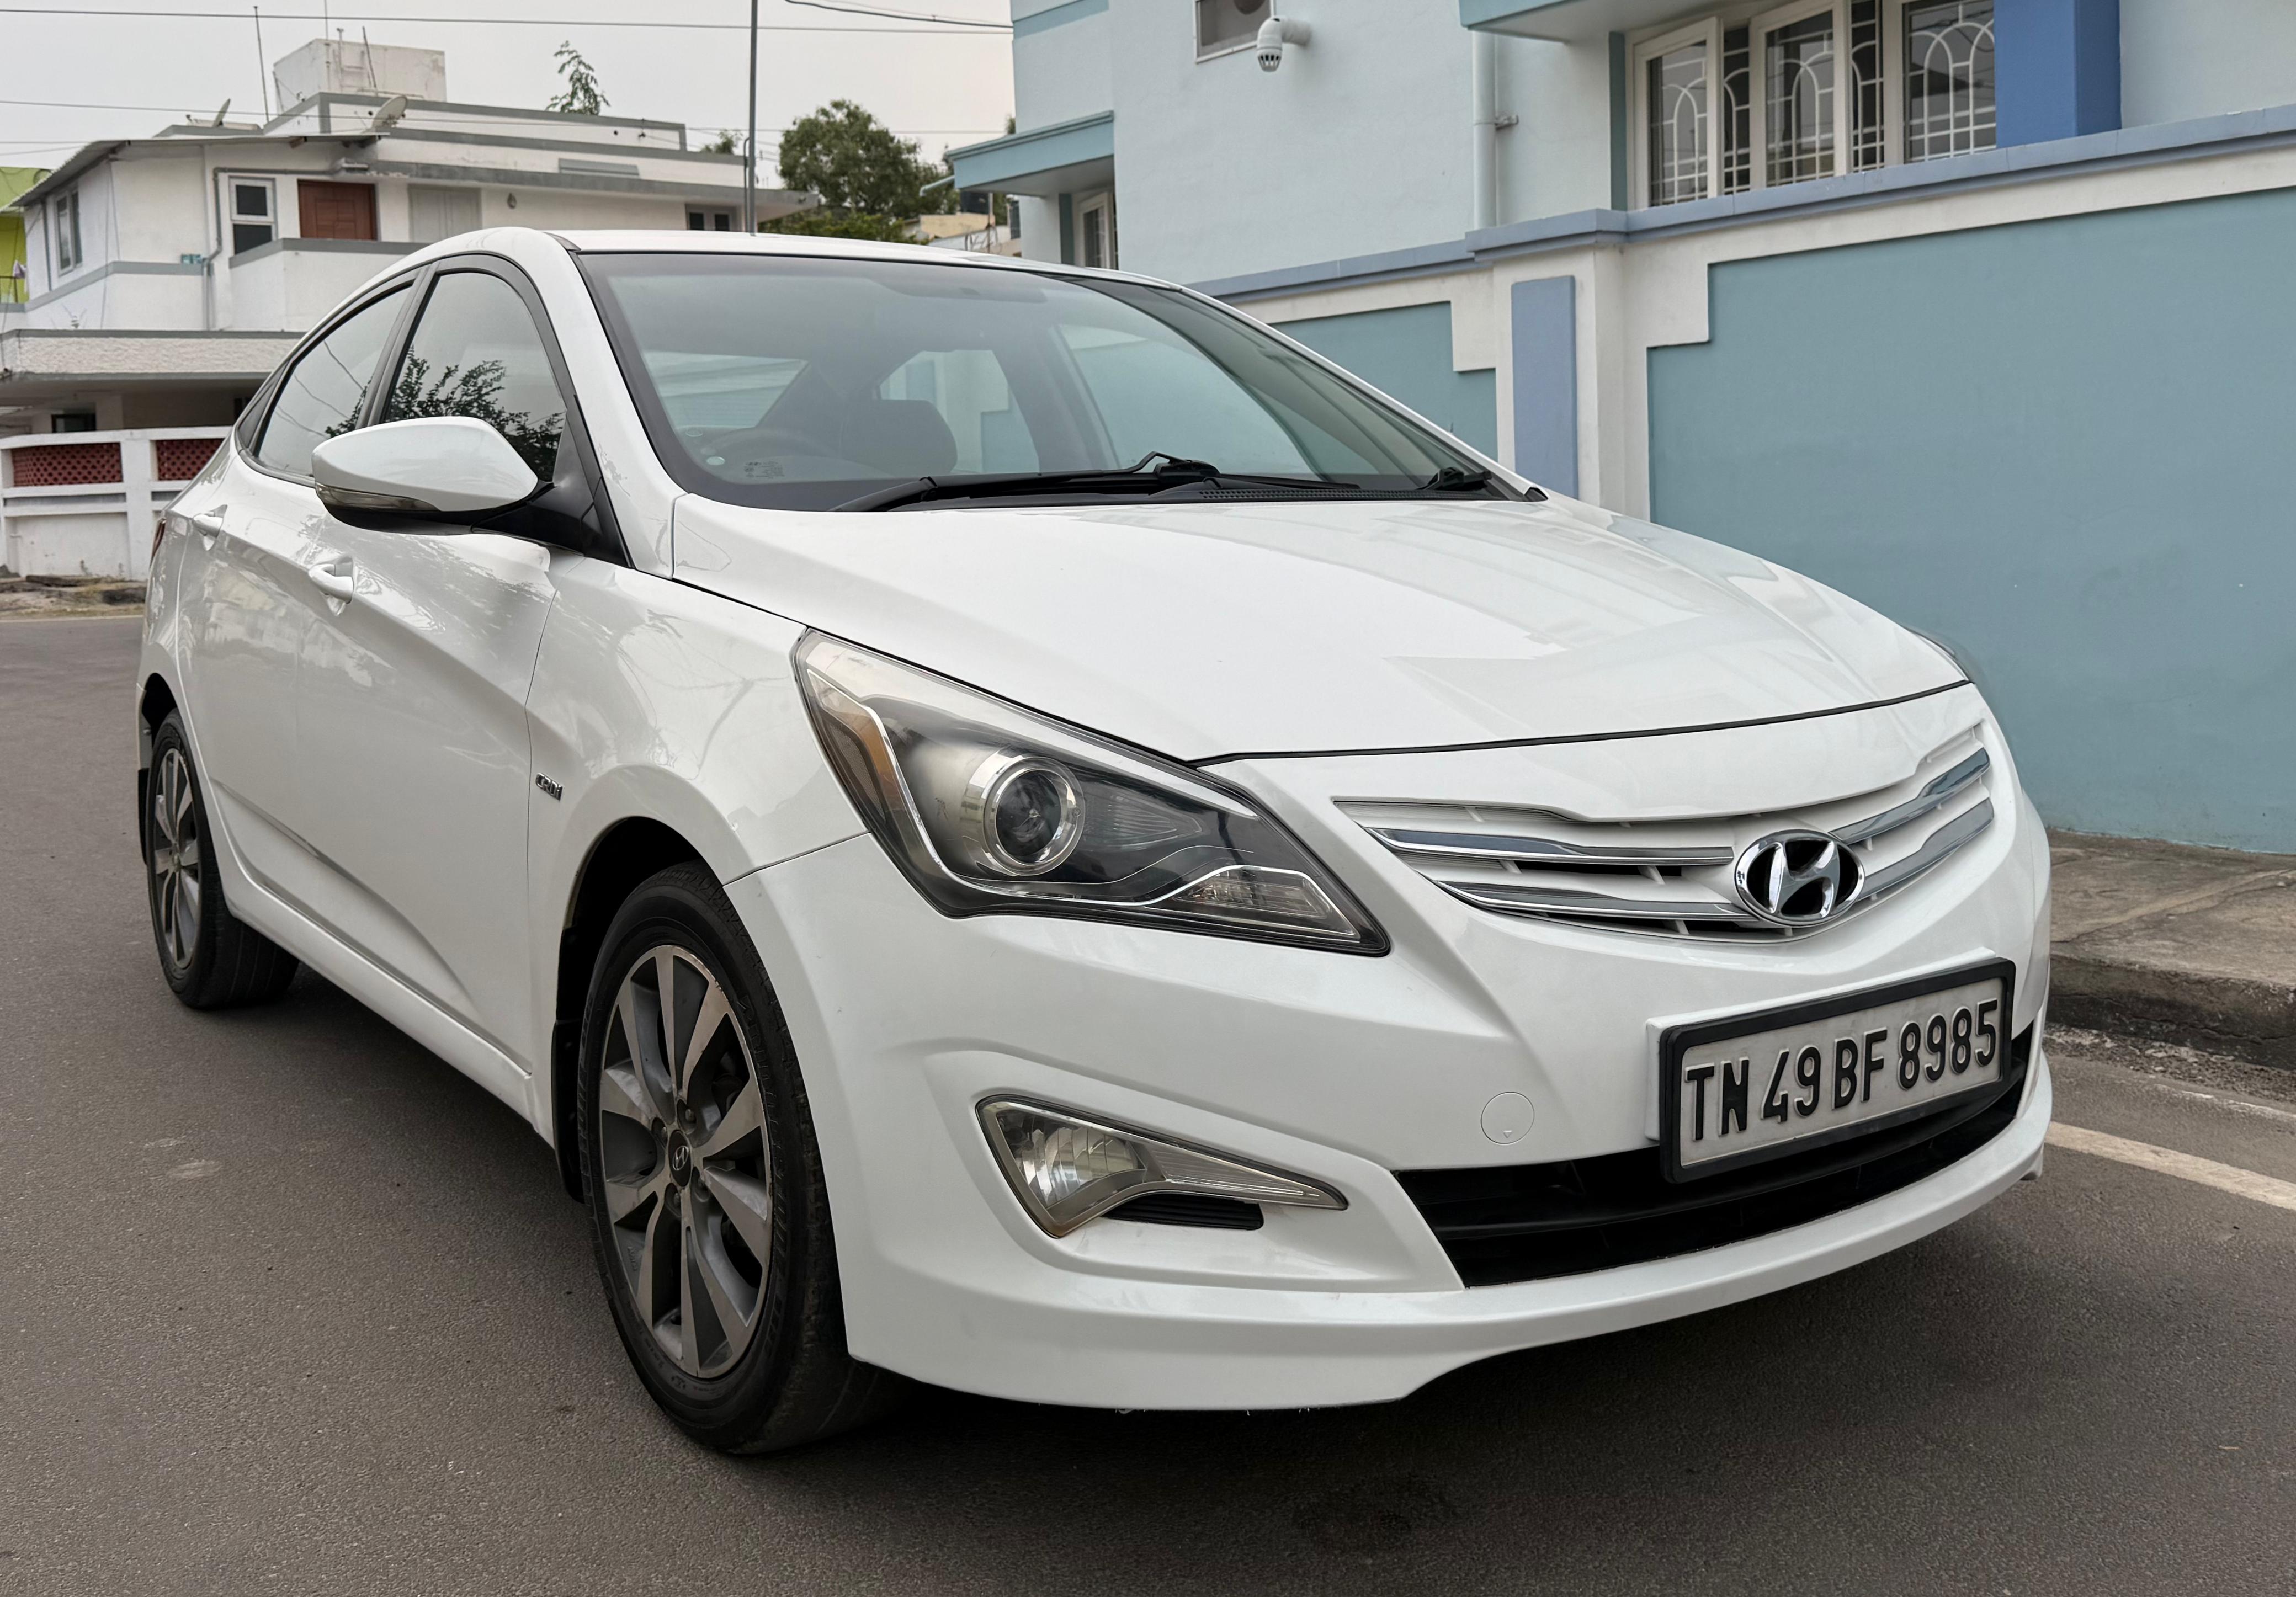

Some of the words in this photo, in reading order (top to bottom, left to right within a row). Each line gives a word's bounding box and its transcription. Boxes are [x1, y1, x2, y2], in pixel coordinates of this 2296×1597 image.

[1685, 1057, 1750, 1141] TN
[1761, 1046, 1821, 1123] 49
[1832, 1027, 1888, 1110] BF
[1897, 999, 1998, 1090] 8985
